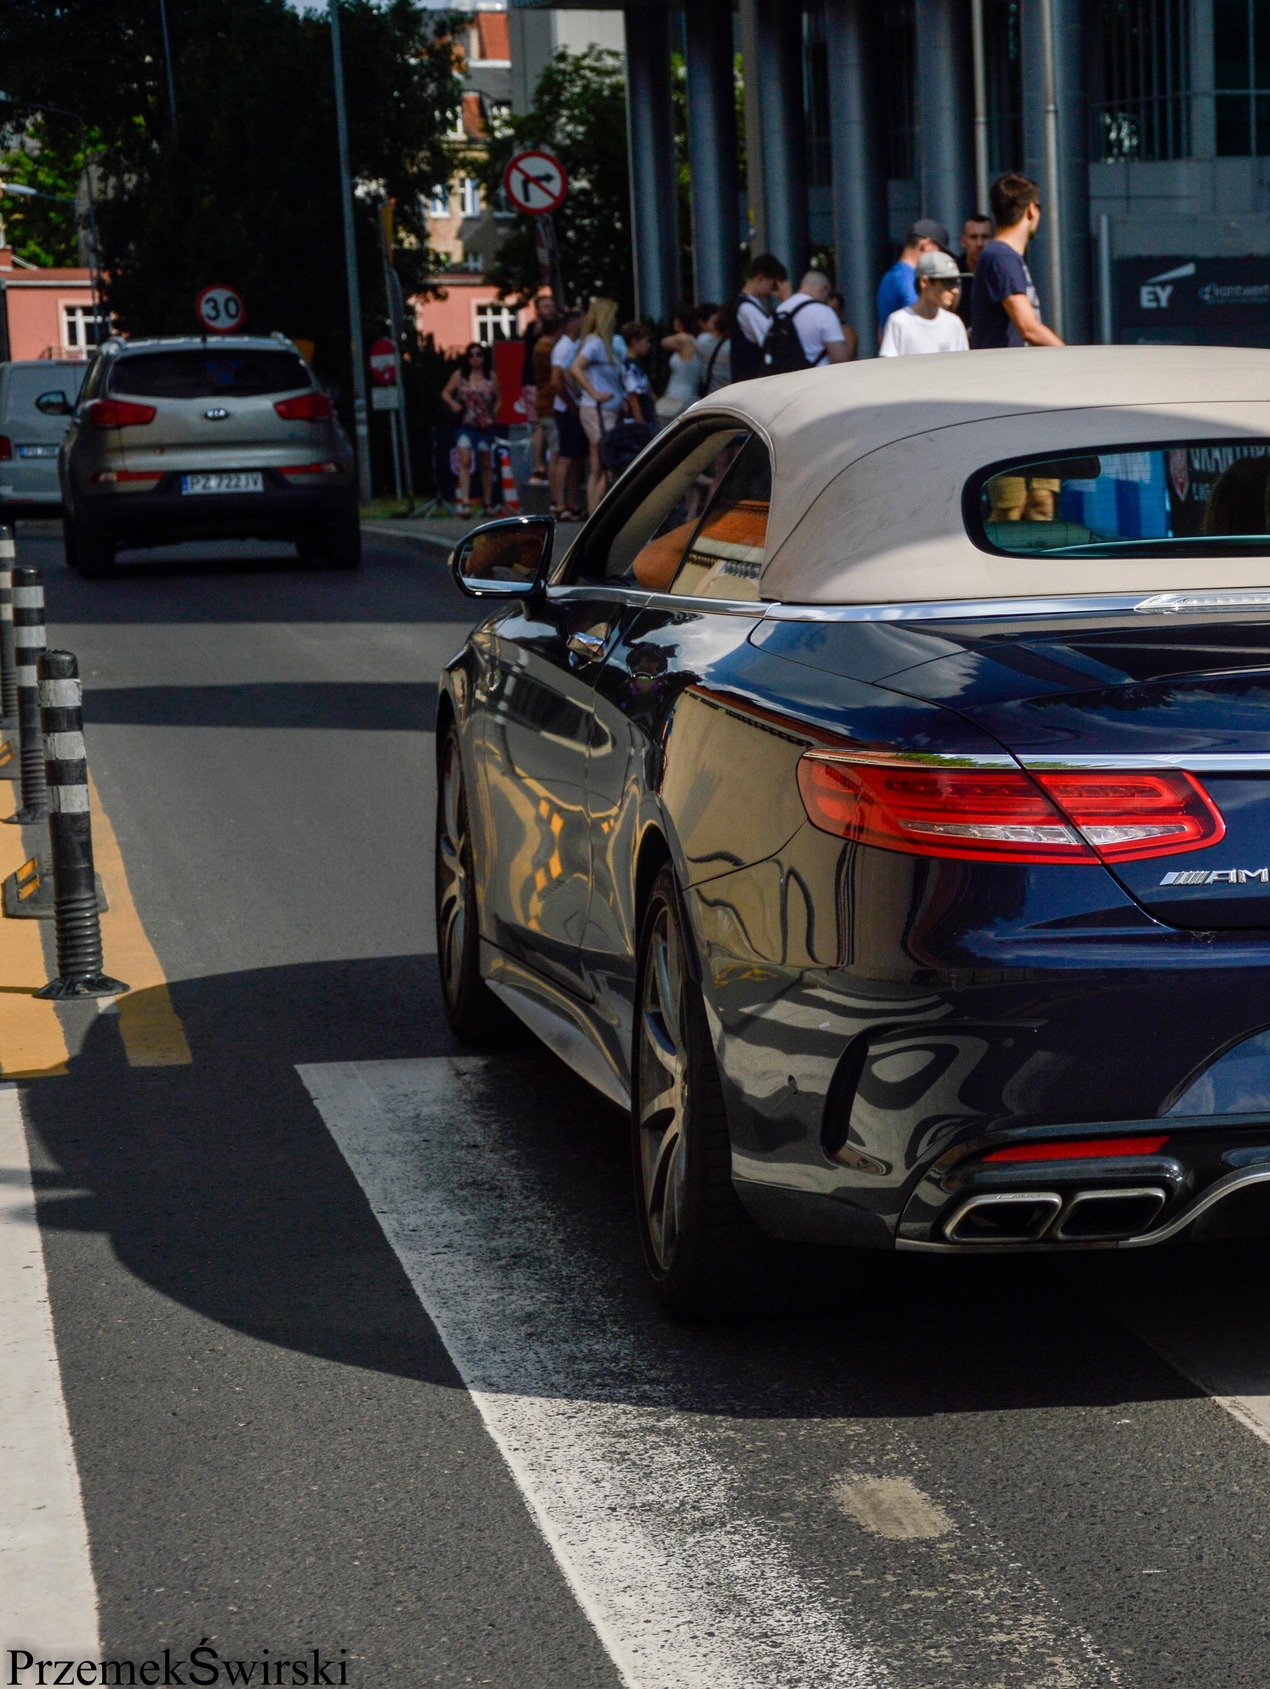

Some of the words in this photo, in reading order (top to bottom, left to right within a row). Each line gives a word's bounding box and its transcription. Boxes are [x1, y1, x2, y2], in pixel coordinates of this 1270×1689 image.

[1140, 285, 1173, 309] EY
[204, 296, 240, 321] 30
[206, 408, 226, 418] KIA
[189, 474, 212, 490] PZ
